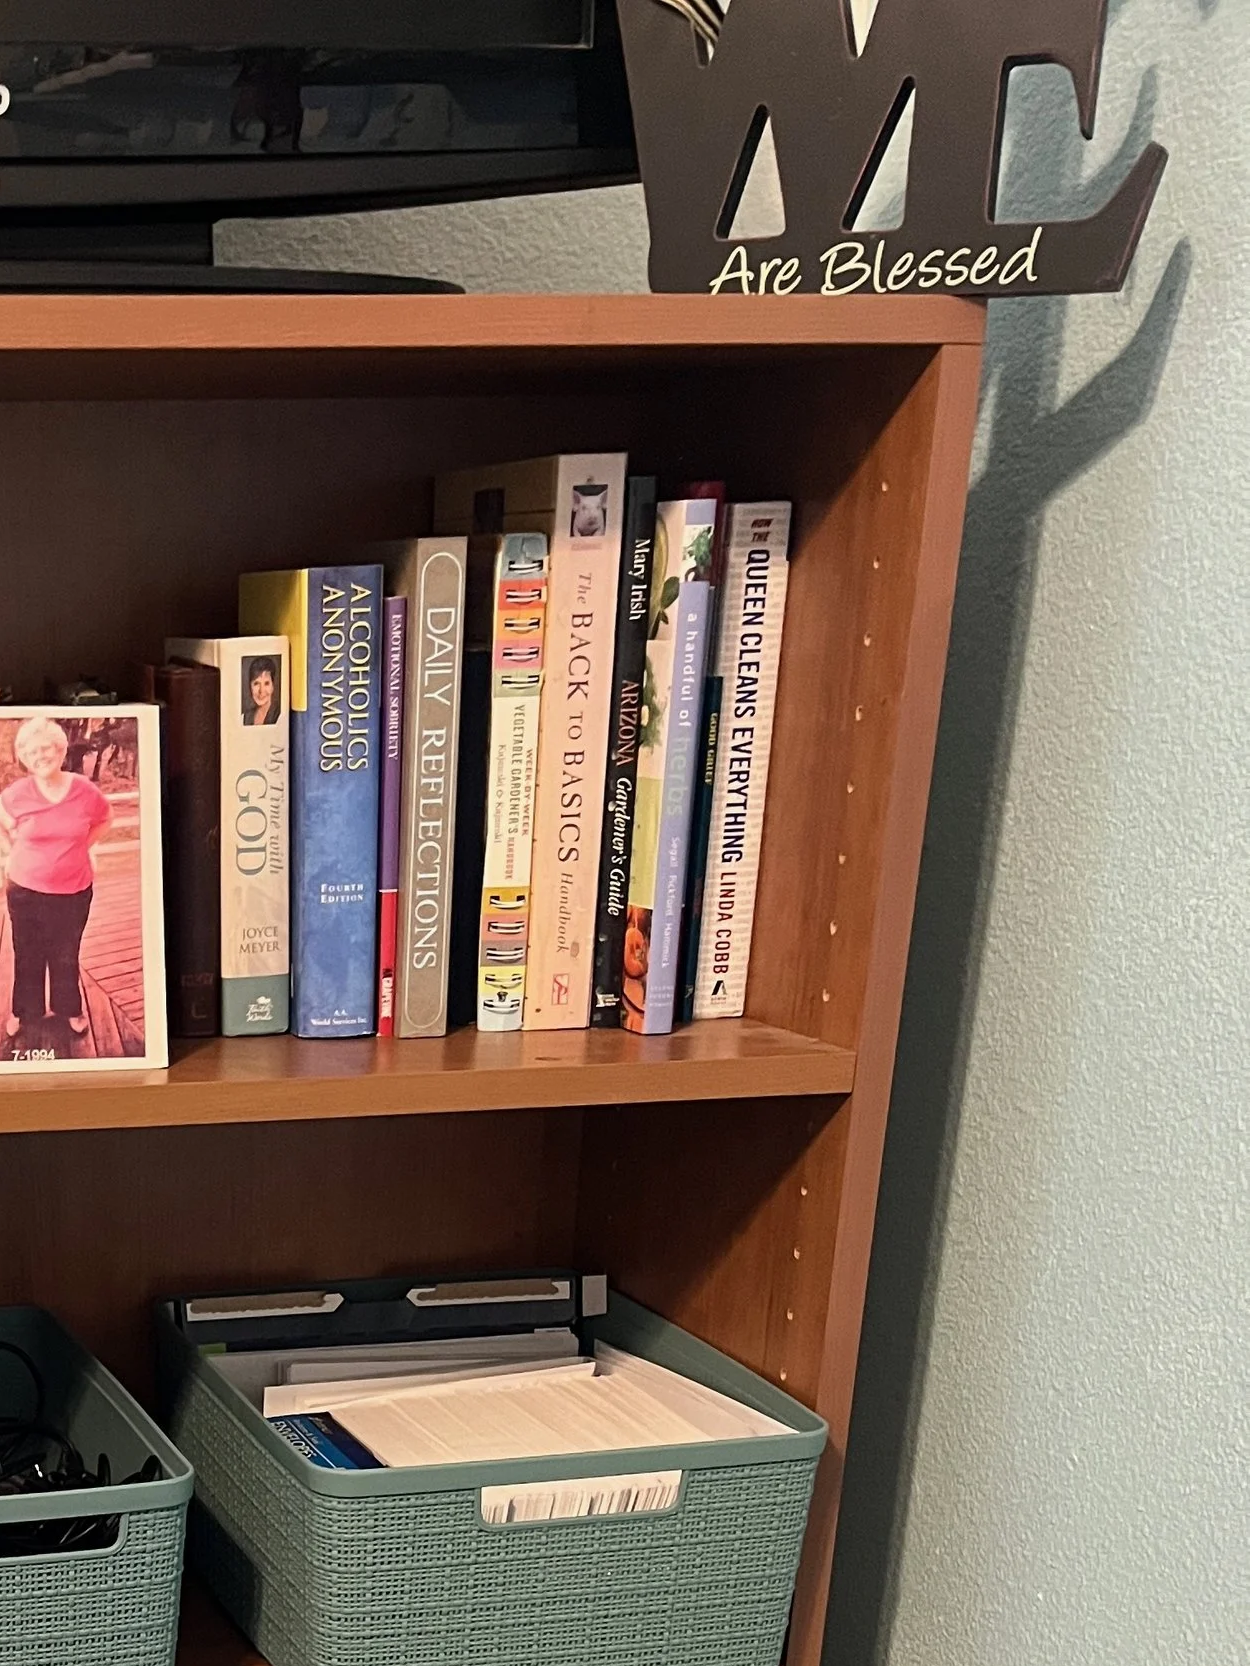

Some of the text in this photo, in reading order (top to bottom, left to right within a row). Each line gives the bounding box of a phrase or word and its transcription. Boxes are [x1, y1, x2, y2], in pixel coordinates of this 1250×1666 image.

[709, 227, 1043, 296] Are Blessed
[751, 531, 771, 542] THE
[628, 538, 651, 621] Mary Irish
[320, 584, 346, 772] ANONYMOUS
[347, 583, 372, 771] ALCOHOLICS
[387, 614, 403, 761] EMOTIONAL SOBRIETY
[667, 612, 698, 817] a handful of herbs
[721, 549, 770, 864] QUEEN CLEANS EVERYTHING
[413, 607, 456, 970] DAILY REFLECTIONS
[556, 572, 594, 953] The BACK TO BASICS Handbook
[704, 712, 718, 784] GOOD GRIEF
[235, 769, 268, 876] GOD
[265, 744, 285, 875] My Time with
[505, 704, 526, 881] VEGETABLE GARDENER'S HANDBOOK
[607, 679, 640, 917] ARIZONA Gardener's Guide
[320, 883, 364, 893] FOURTH
[320, 894, 364, 904] EDITION
[664, 875, 678, 917] Pickford
[717, 871, 737, 922] LINDA
[239, 941, 281, 954] MEYER
[242, 926, 279, 940] JOYCE
[713, 928, 732, 975] COBB
[11, 1049, 56, 1062] 7-1994
